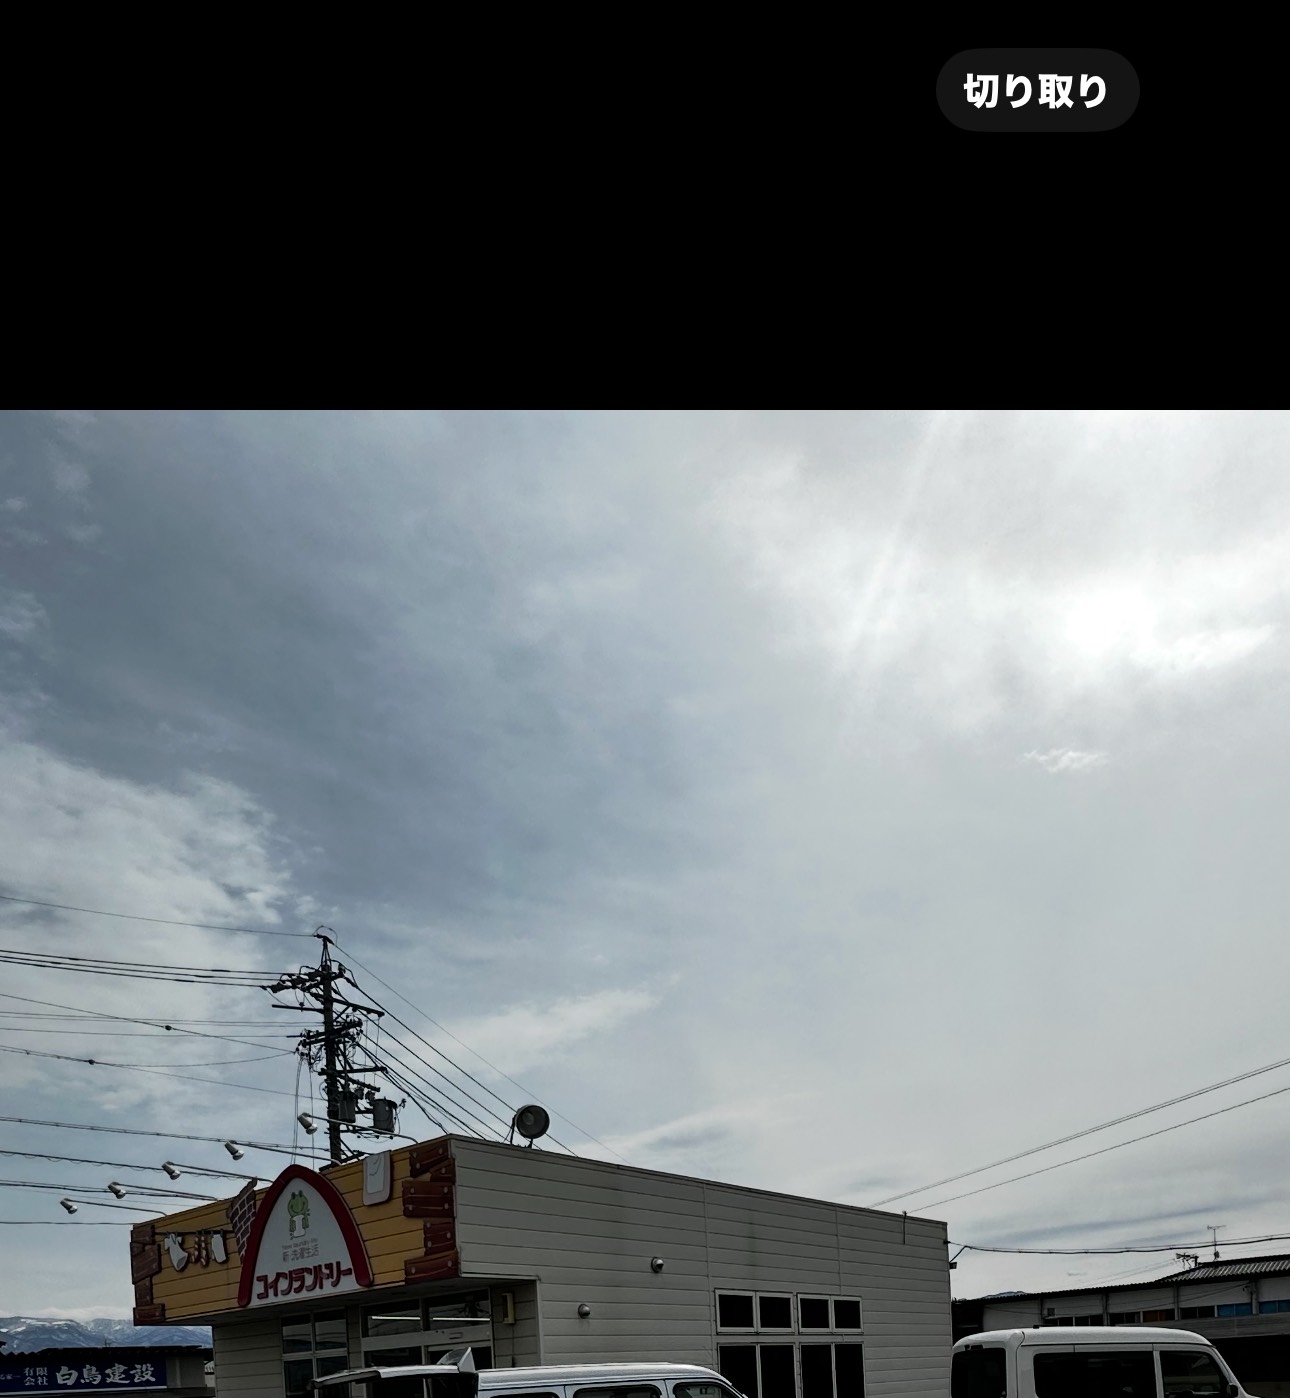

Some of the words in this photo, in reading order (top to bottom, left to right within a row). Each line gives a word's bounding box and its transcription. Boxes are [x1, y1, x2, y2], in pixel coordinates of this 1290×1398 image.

[256, 1261, 352, 1299] コインランドリー
[55, 1362, 156, 1386] 白鳥建設
